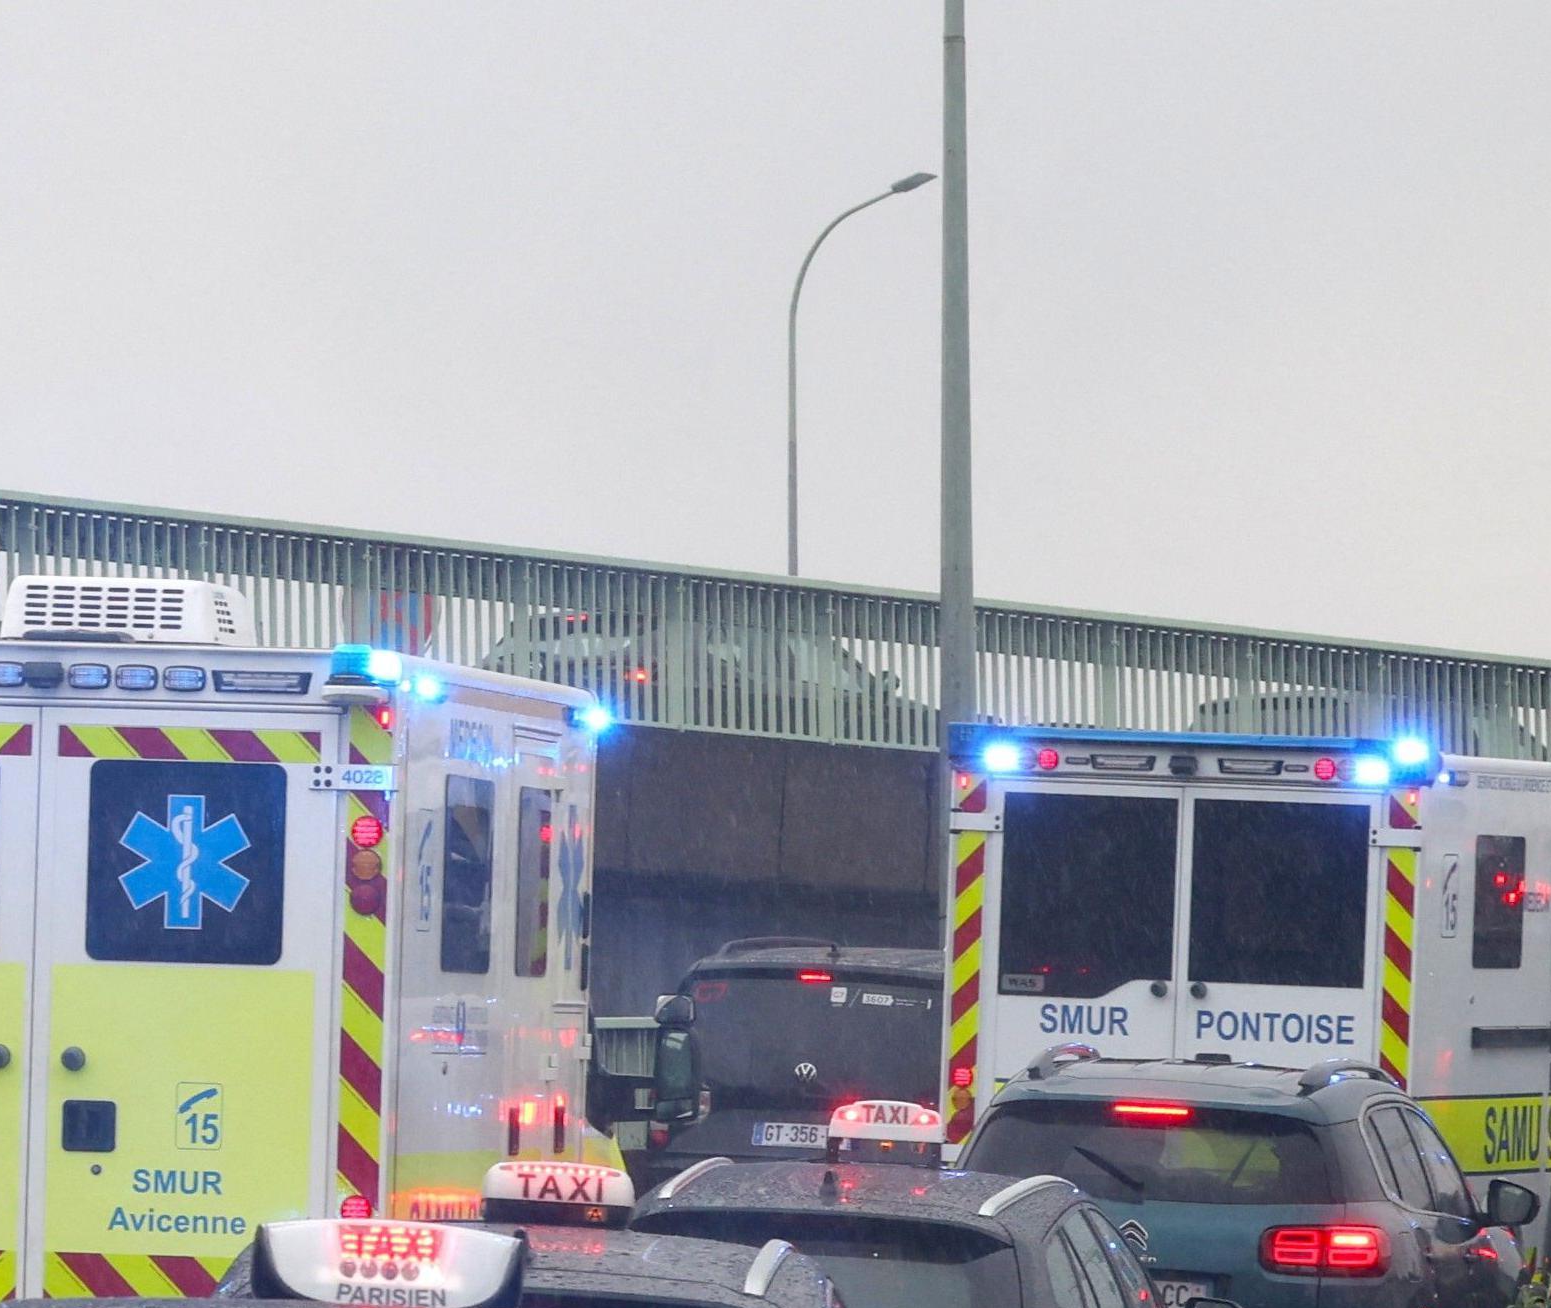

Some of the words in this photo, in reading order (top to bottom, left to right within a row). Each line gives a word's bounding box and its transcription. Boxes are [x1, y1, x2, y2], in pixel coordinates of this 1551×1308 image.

[342, 769, 384, 785] 4028
[1039, 1003, 1130, 1036] SMUR
[1196, 1008, 1355, 1046] PONTOISE
[185, 1113, 219, 1145] 15
[861, 1104, 909, 1126] TAXI
[1484, 1105, 1542, 1164] SAMU
[132, 1168, 223, 1195] SMUR
[517, 1173, 604, 1203] TAXI
[108, 1206, 247, 1236] Avicenne
[335, 1282, 447, 1308] PARISIEN
